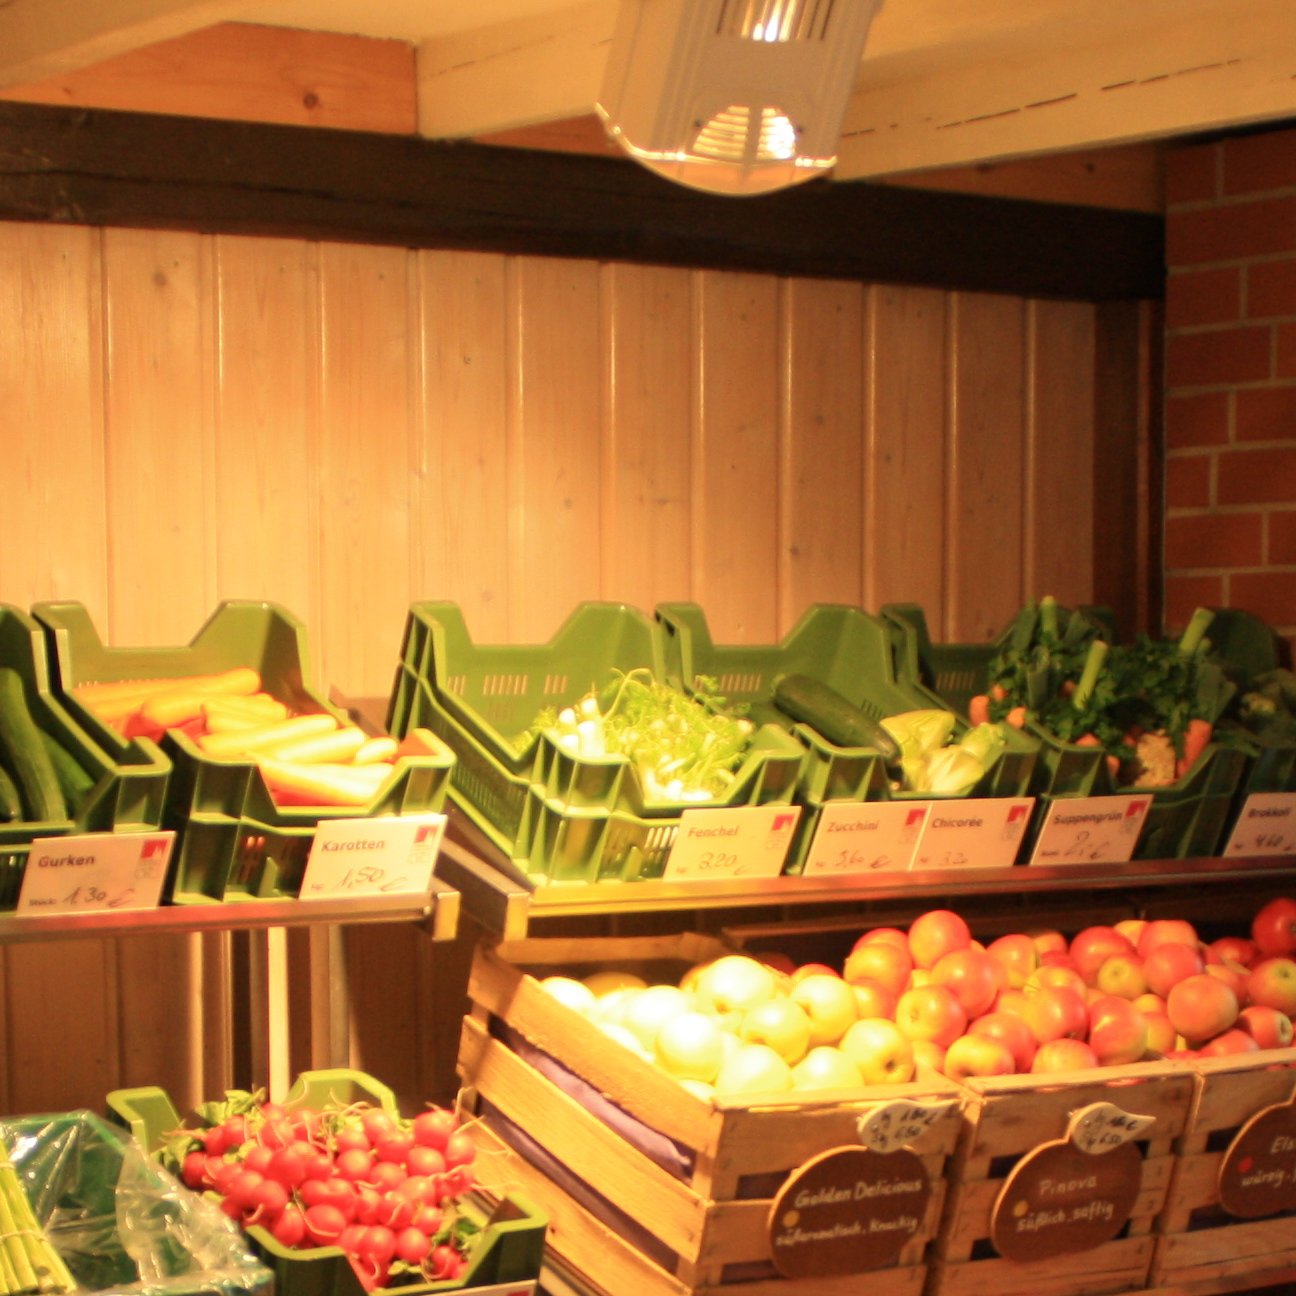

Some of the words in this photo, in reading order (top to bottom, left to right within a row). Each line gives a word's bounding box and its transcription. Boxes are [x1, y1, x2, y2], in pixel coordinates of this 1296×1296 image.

[1053, 810, 1123, 825] Suppengrün
[687, 825, 740, 838] Fenchel
[826, 820, 880, 833] Zucchini
[321, 839, 386, 852] Karotten
[37, 854, 96, 868] Gurken
[793, 1186, 851, 1208] Golden
[855, 1178, 923, 1200] Delicious
[1038, 1176, 1098, 1196] Pinova
